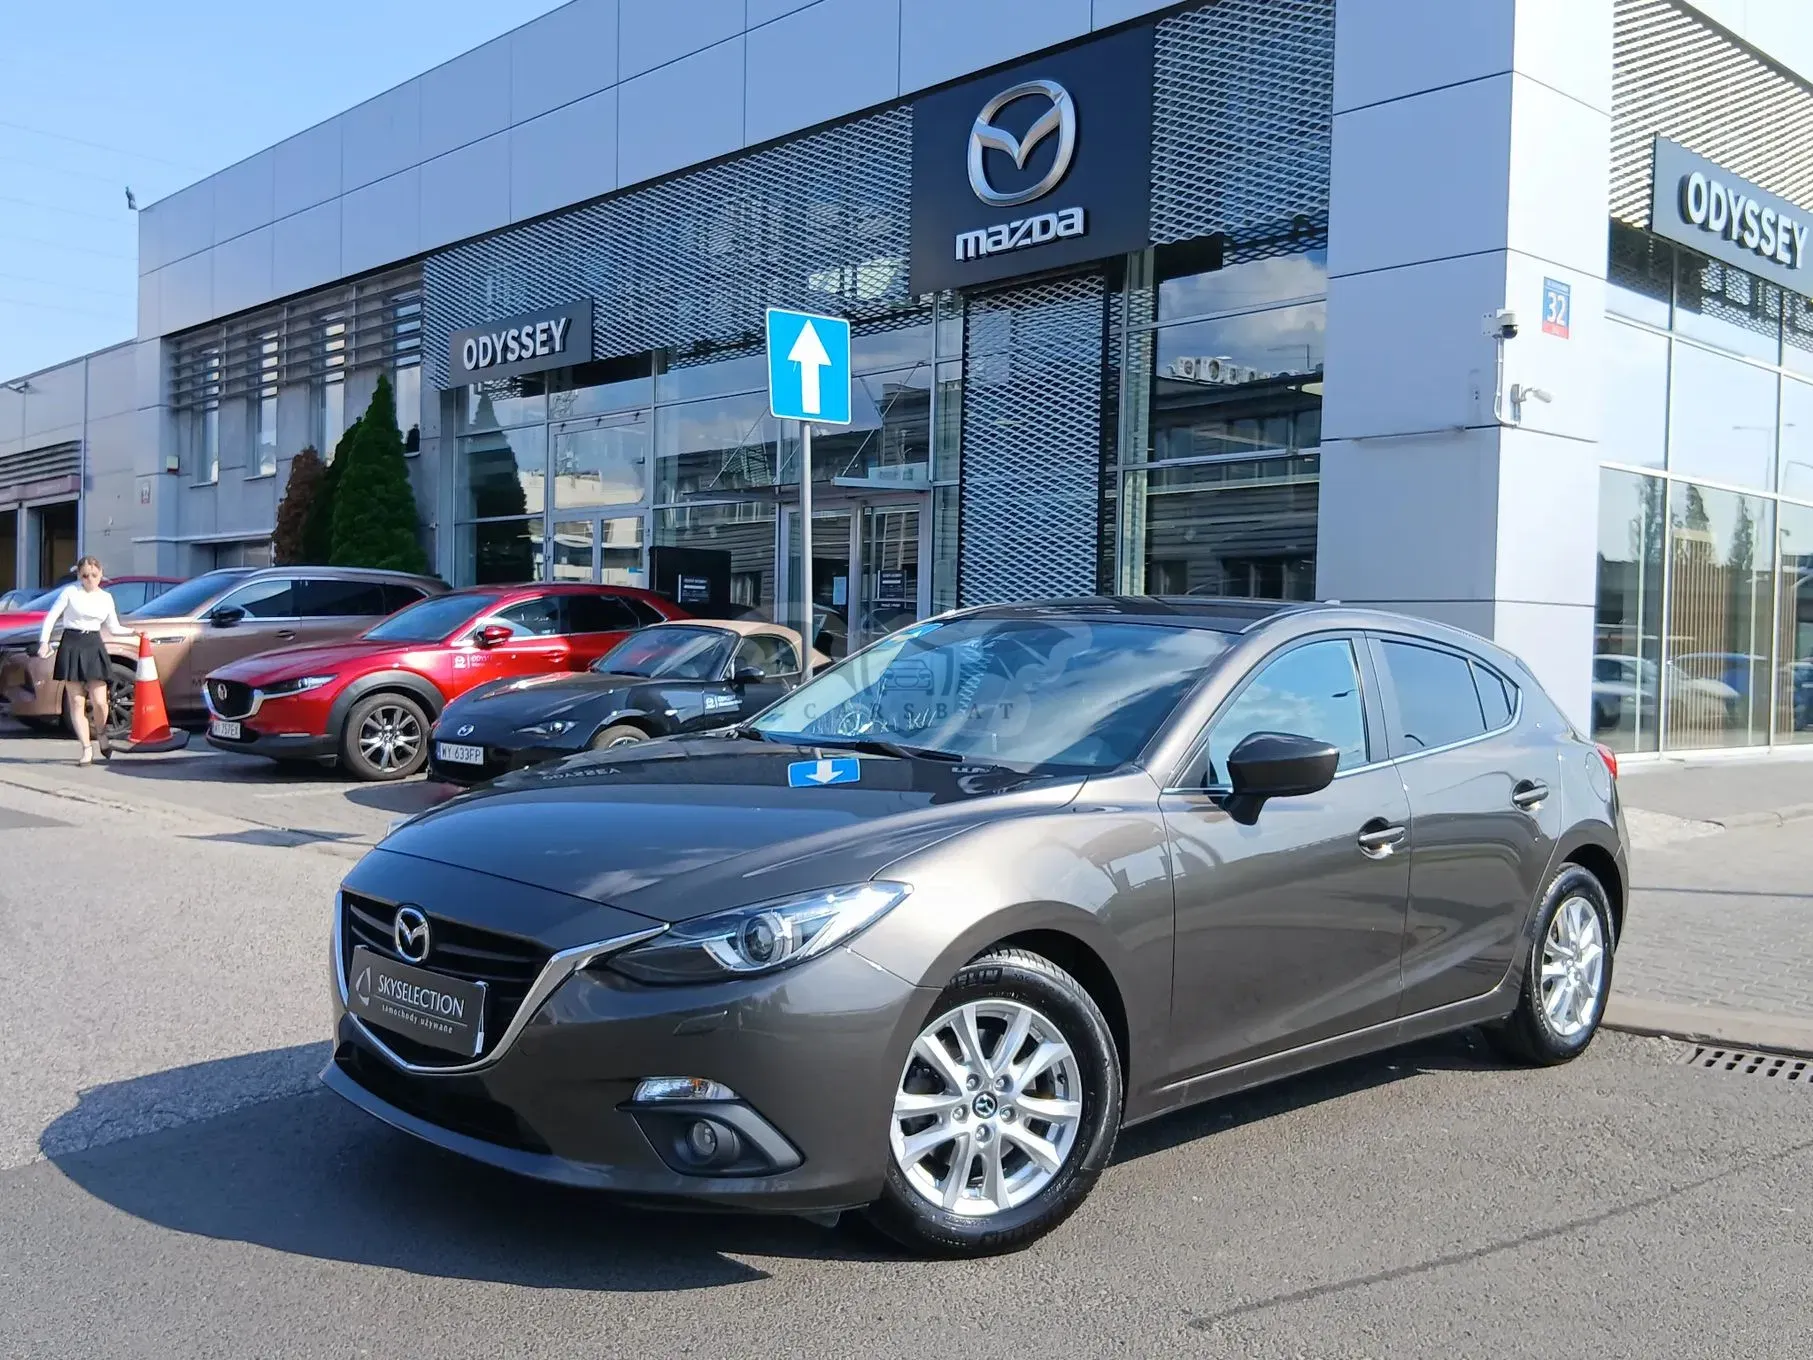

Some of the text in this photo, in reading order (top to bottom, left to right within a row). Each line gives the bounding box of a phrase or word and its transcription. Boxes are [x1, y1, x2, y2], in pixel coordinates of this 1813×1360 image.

[1687, 171, 1809, 269] ODYSSEY
[1547, 291, 1566, 325] 32
[463, 317, 567, 371] ODYSSEY
[454, 745, 481, 762] 633FP
[377, 974, 465, 1018] SKYSELECTION
[382, 1004, 454, 1034] samochody używane
